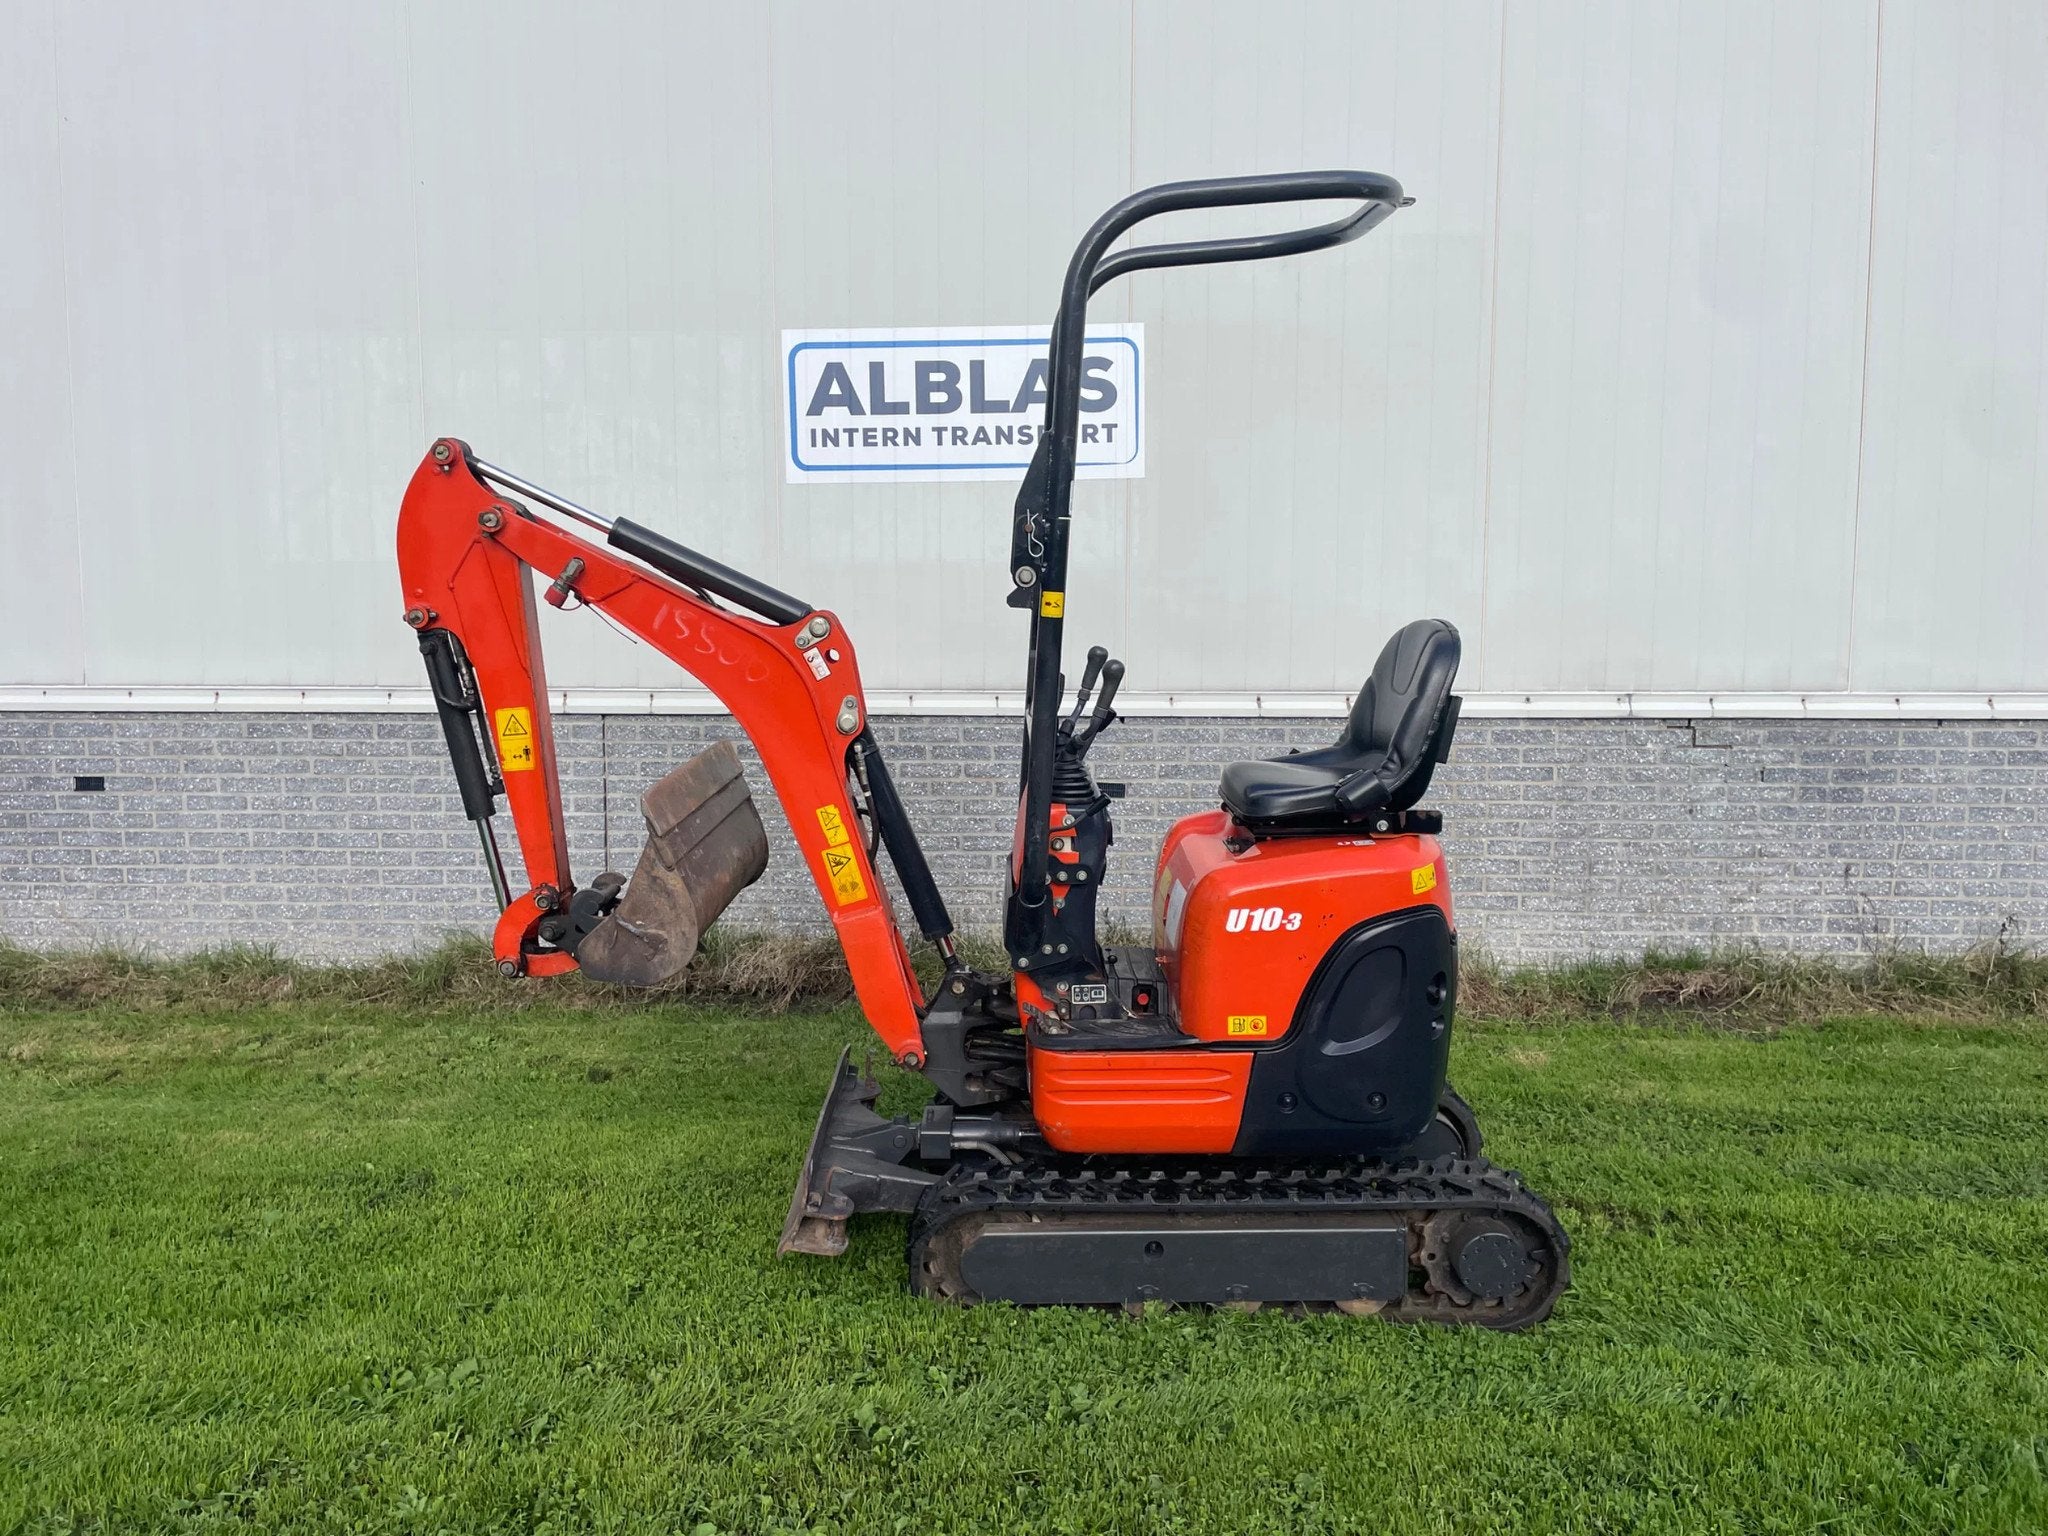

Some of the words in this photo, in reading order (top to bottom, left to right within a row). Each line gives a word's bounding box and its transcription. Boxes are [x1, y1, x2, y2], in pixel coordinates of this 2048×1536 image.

[806, 356, 1118, 417] ALBLAS
[810, 426, 922, 448] INTERN
[932, 423, 1119, 447] TRANSRT
[1225, 907, 1302, 933] U10-3
